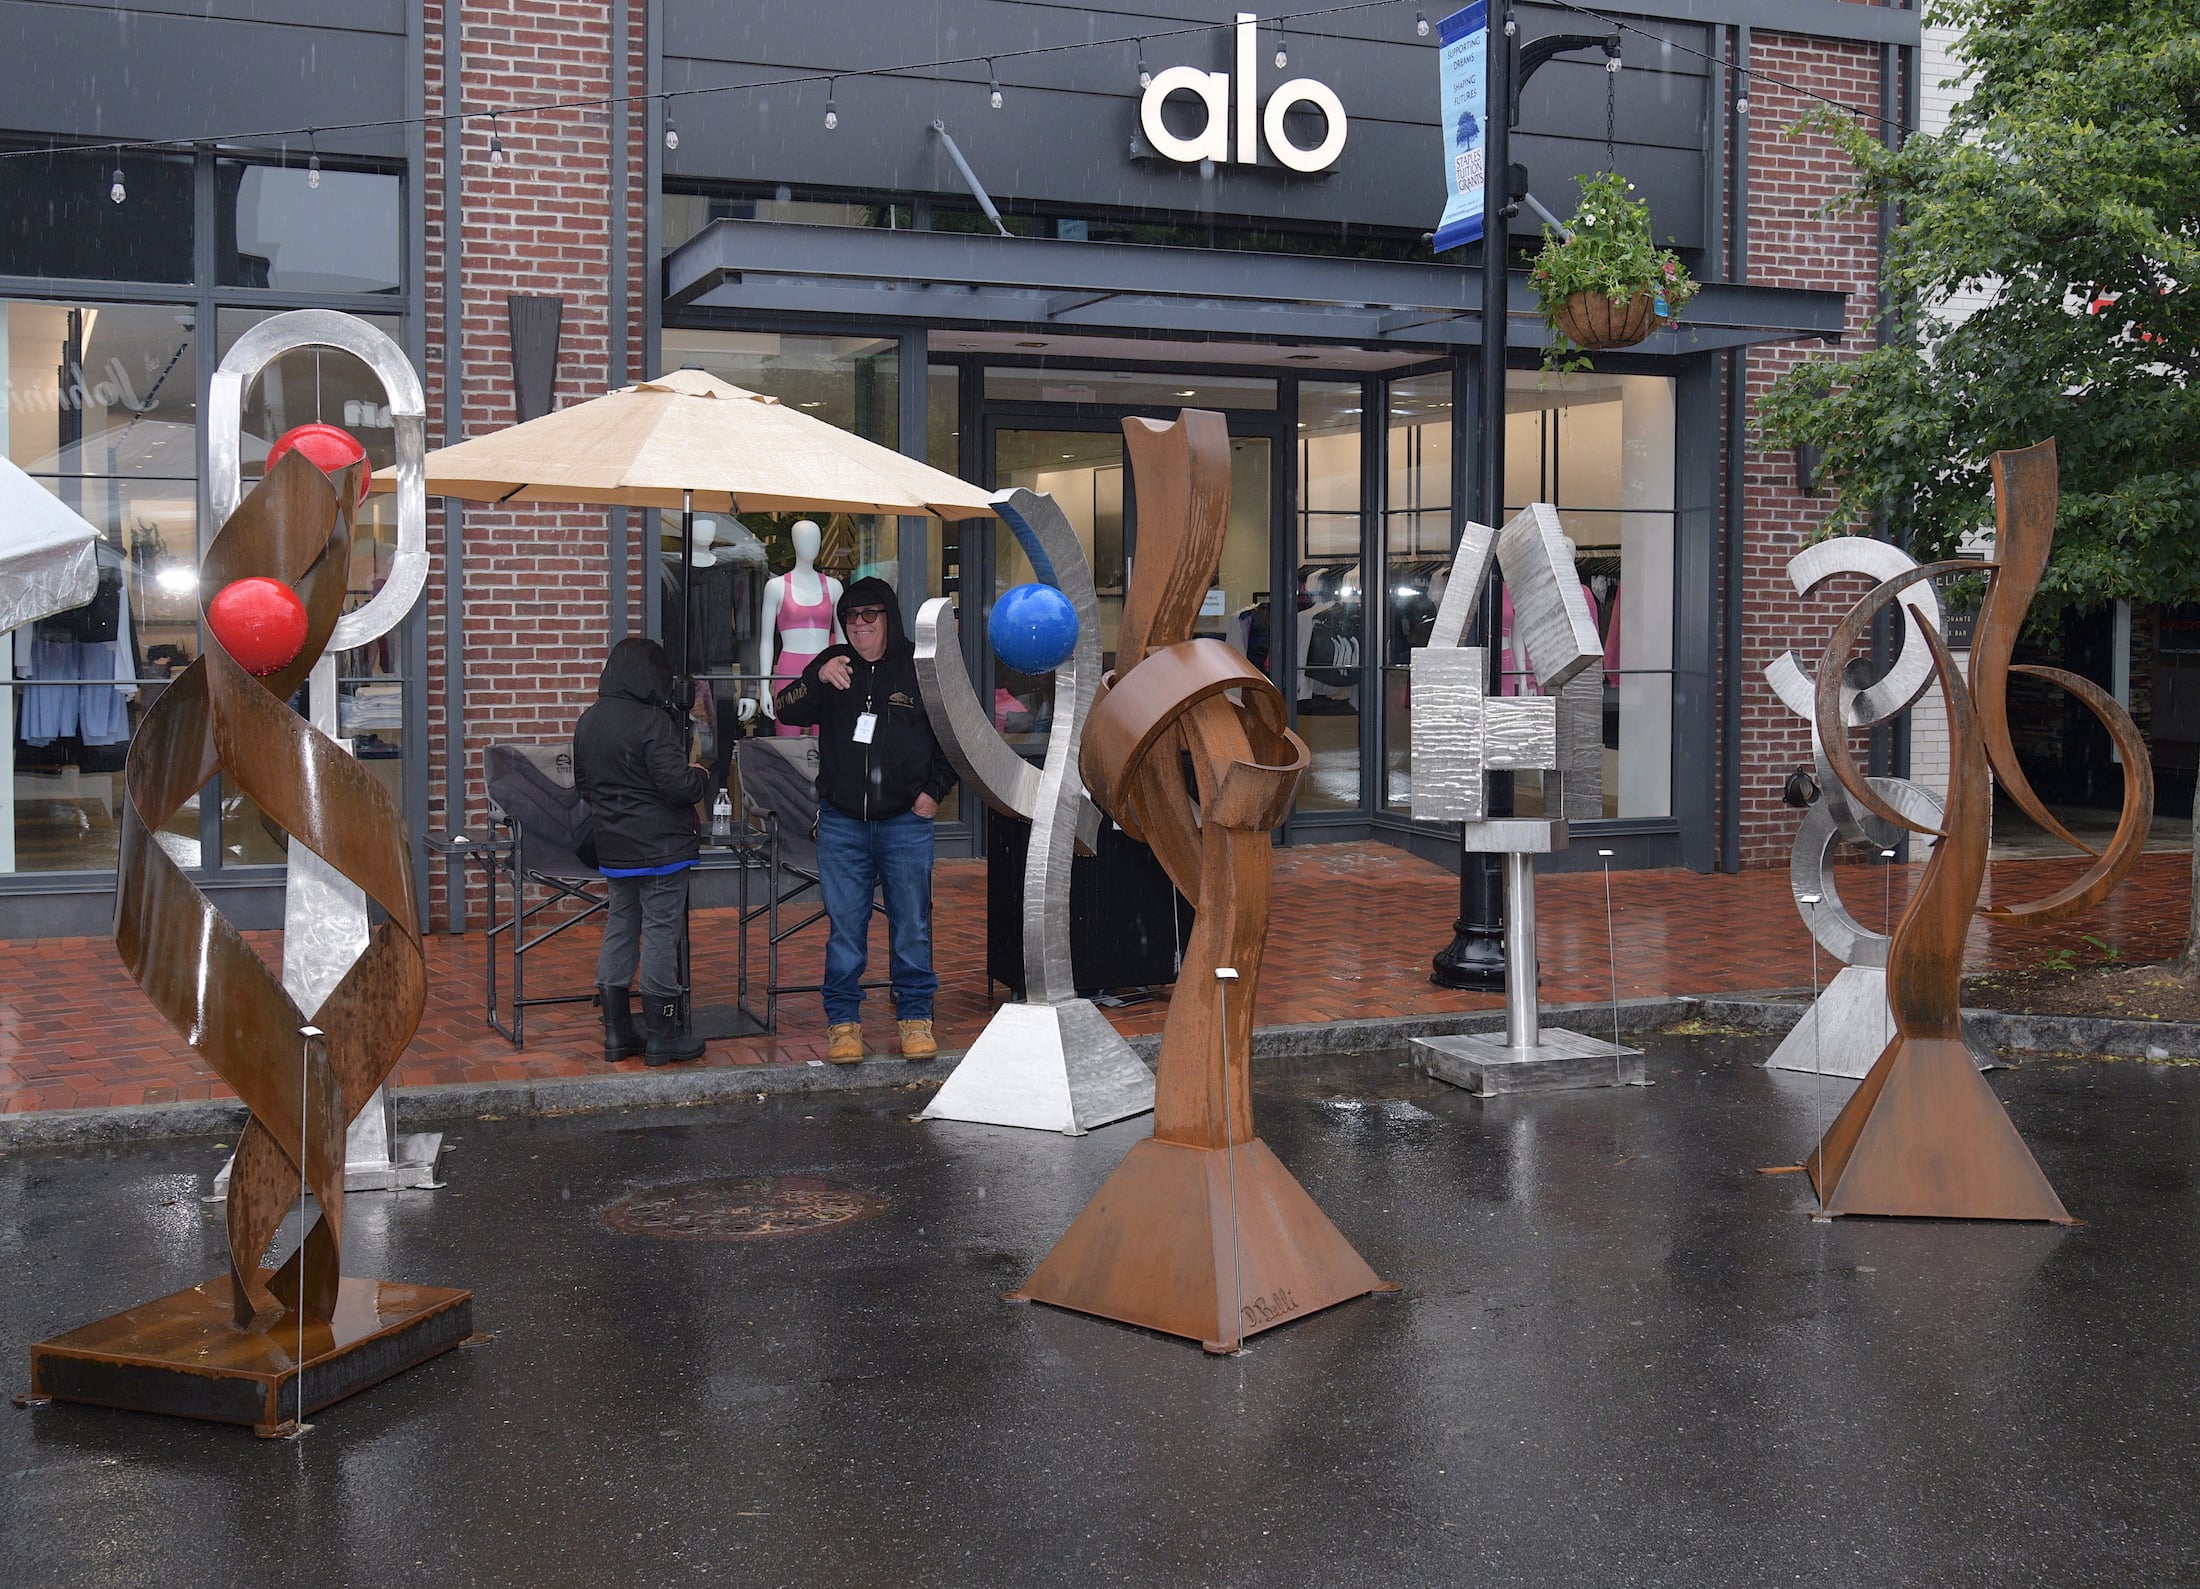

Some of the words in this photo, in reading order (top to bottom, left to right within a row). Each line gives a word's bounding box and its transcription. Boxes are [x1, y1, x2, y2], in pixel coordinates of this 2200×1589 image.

[1447, 35, 1481, 60] SUPPORTING
[1453, 52, 1475, 70] DREAMS
[1140, 13, 1348, 172] alo
[1453, 74, 1476, 93] SHAPING
[1454, 88, 1477, 106] FUTURES
[1456, 149, 1481, 169] STAPLES
[1457, 161, 1482, 180] TUITION
[1458, 172, 1484, 192] GRANTS
